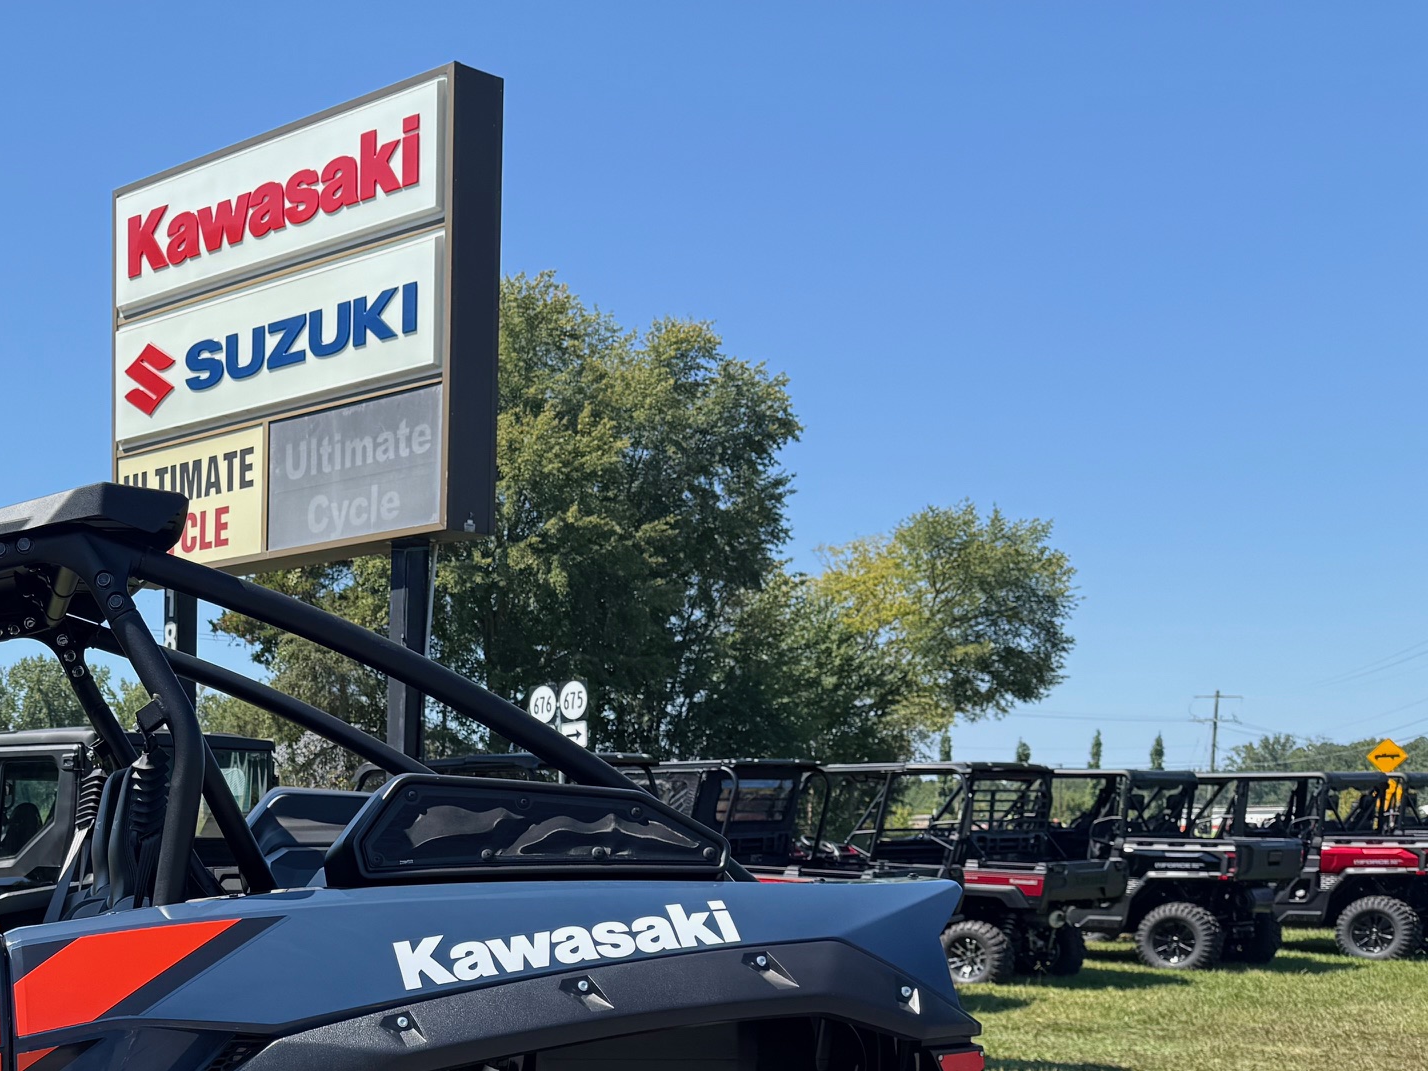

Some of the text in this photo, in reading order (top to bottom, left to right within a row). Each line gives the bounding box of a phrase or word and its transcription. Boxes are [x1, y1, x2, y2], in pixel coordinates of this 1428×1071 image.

[127, 113, 420, 279] Kawasaki
[185, 281, 418, 391] SUZUKI
[285, 418, 432, 480] Ultimate
[307, 484, 401, 539] Cycle
[533, 696, 552, 715] 676
[563, 691, 583, 710] 675
[392, 900, 742, 991] Kawasaki
